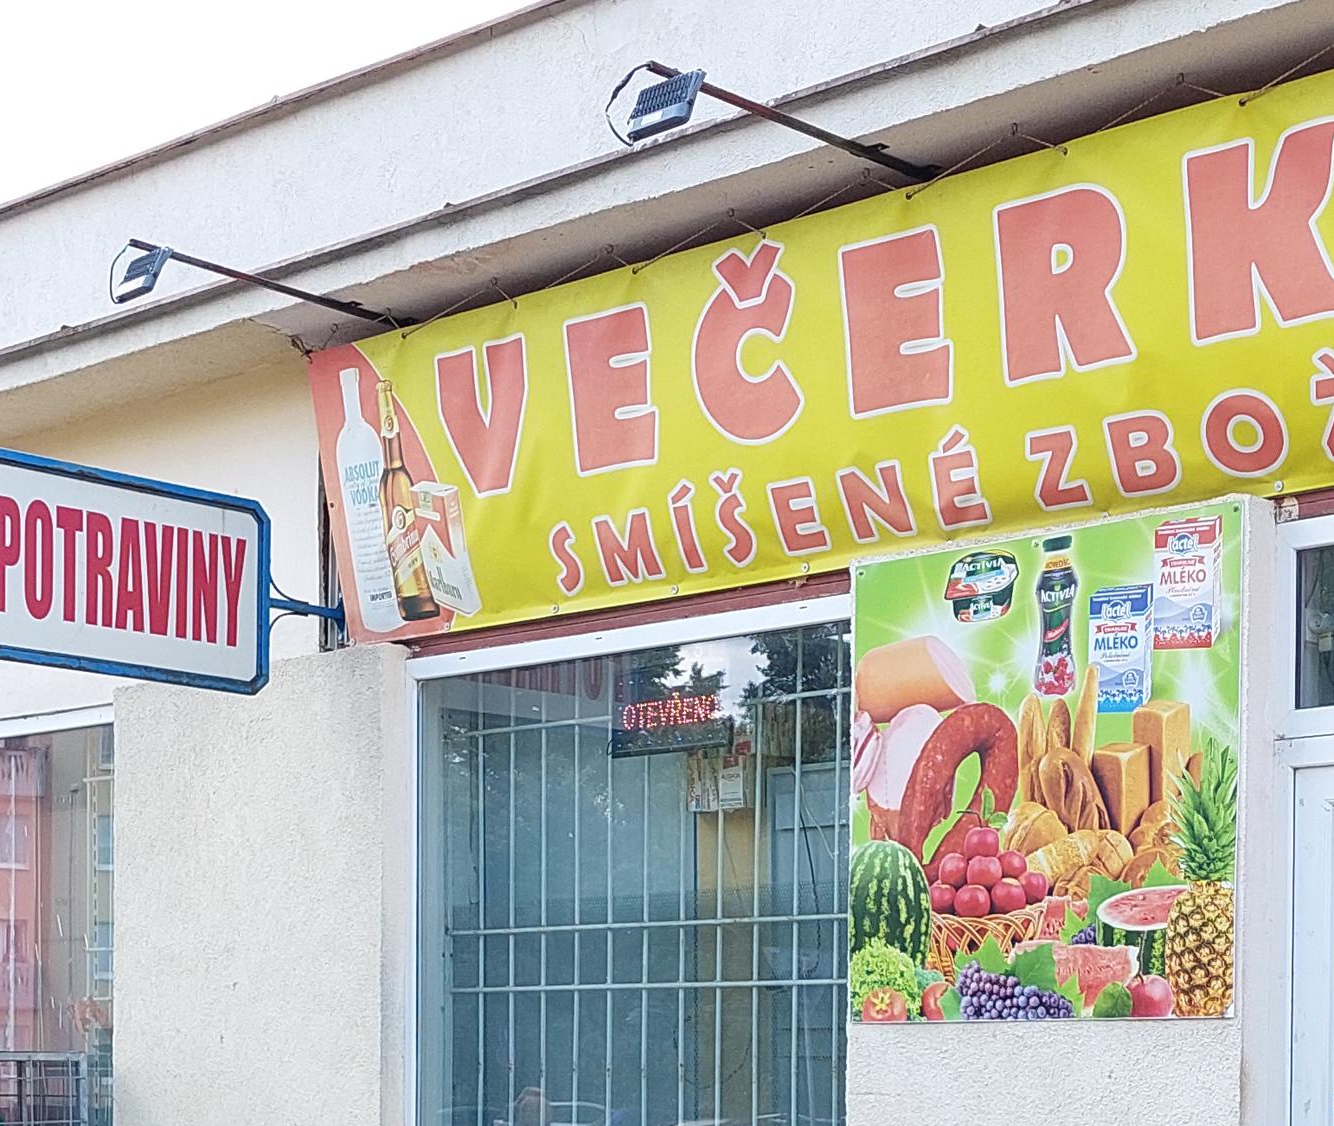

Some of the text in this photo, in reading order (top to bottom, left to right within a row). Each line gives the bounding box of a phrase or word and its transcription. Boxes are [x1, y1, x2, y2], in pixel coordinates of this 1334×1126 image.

[344, 460, 380, 484] ABSOLUT
[549, 425, 994, 596] SMÍŠENÉ
[963, 557, 1006, 572] ACTIVIA
[1159, 566, 1207, 586] MLÉKO
[1040, 583, 1076, 603] ACTIVIA
[1094, 632, 1139, 651] MLÉKO
